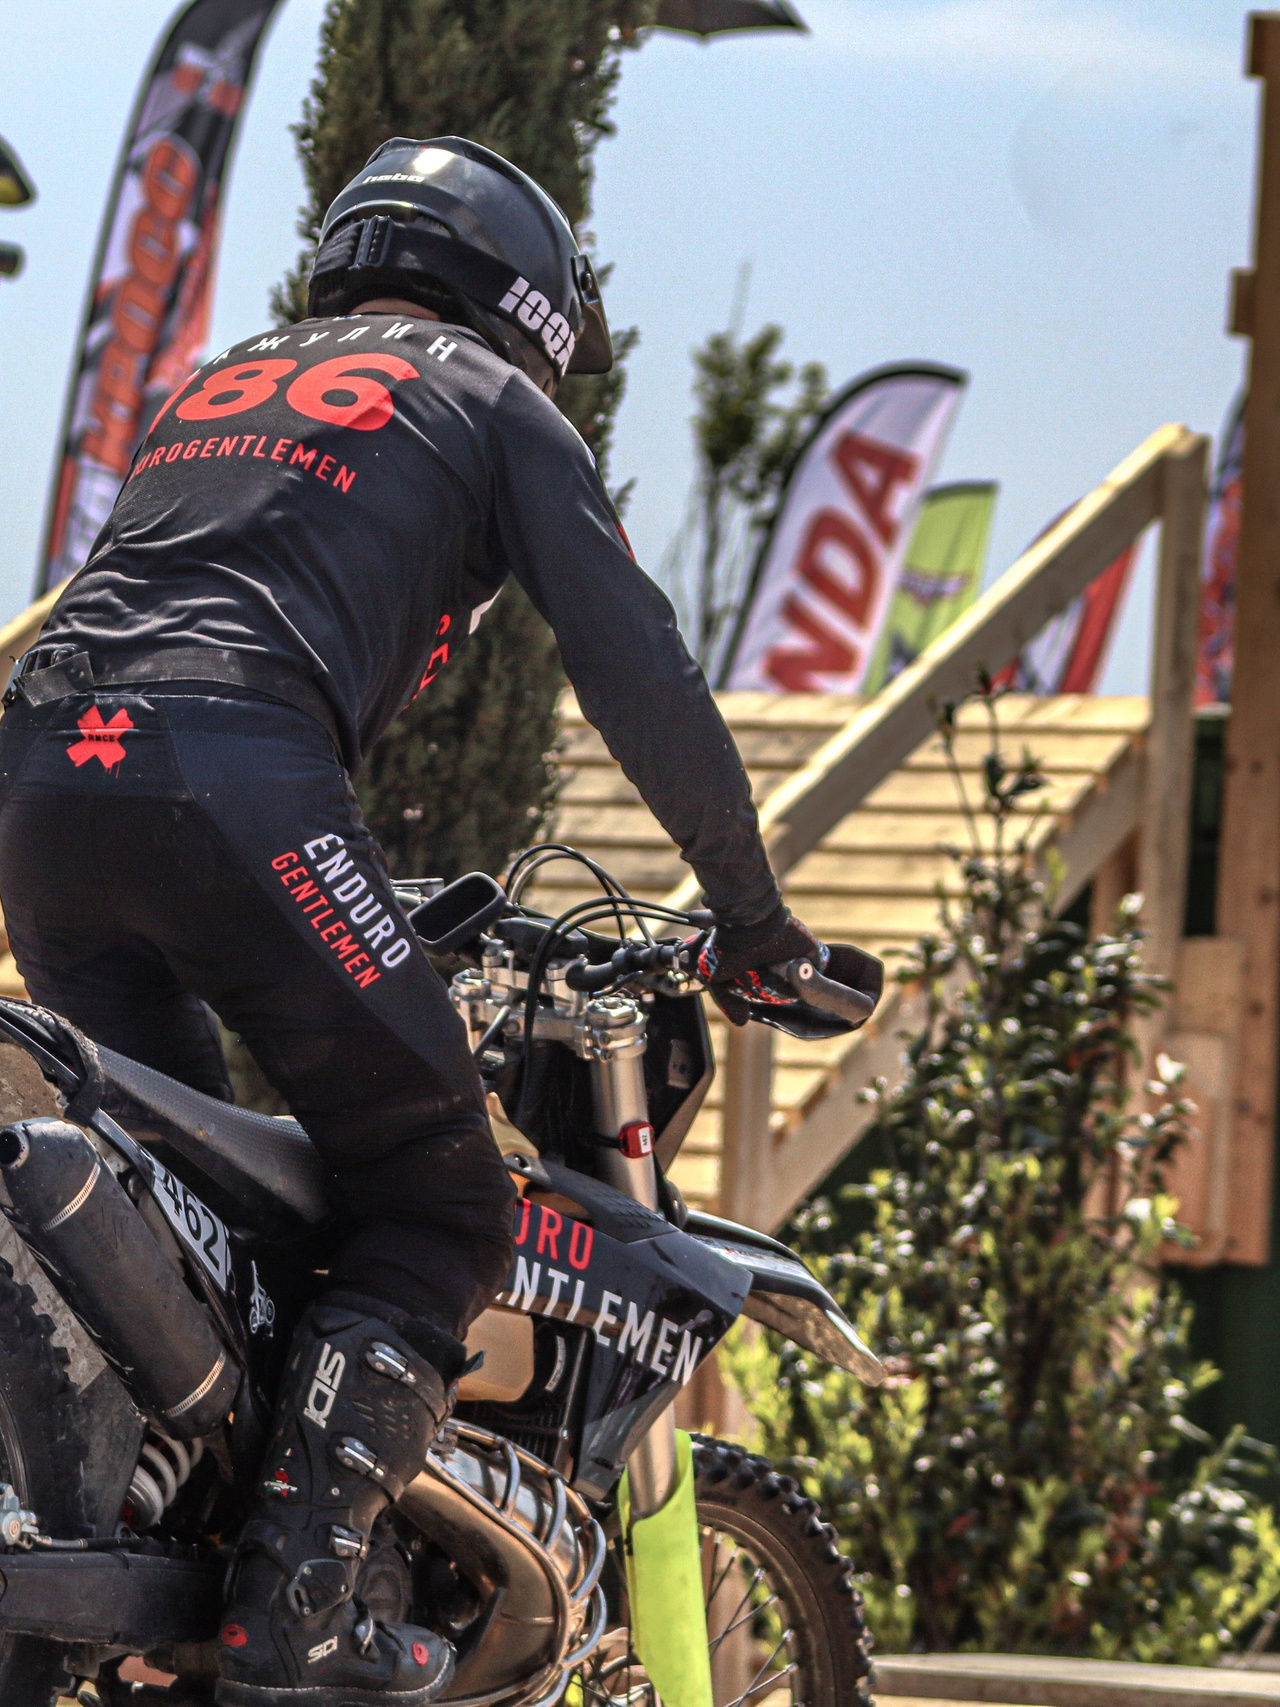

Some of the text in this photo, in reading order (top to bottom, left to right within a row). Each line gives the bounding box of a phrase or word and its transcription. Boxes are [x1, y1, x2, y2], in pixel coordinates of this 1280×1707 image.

[126, 434, 357, 494] UROGENTLEMEN
[270, 850, 382, 990] GENTLEMEN
[303, 832, 412, 969] ENDURO
[495, 1254, 703, 1387] NTLEMEN
